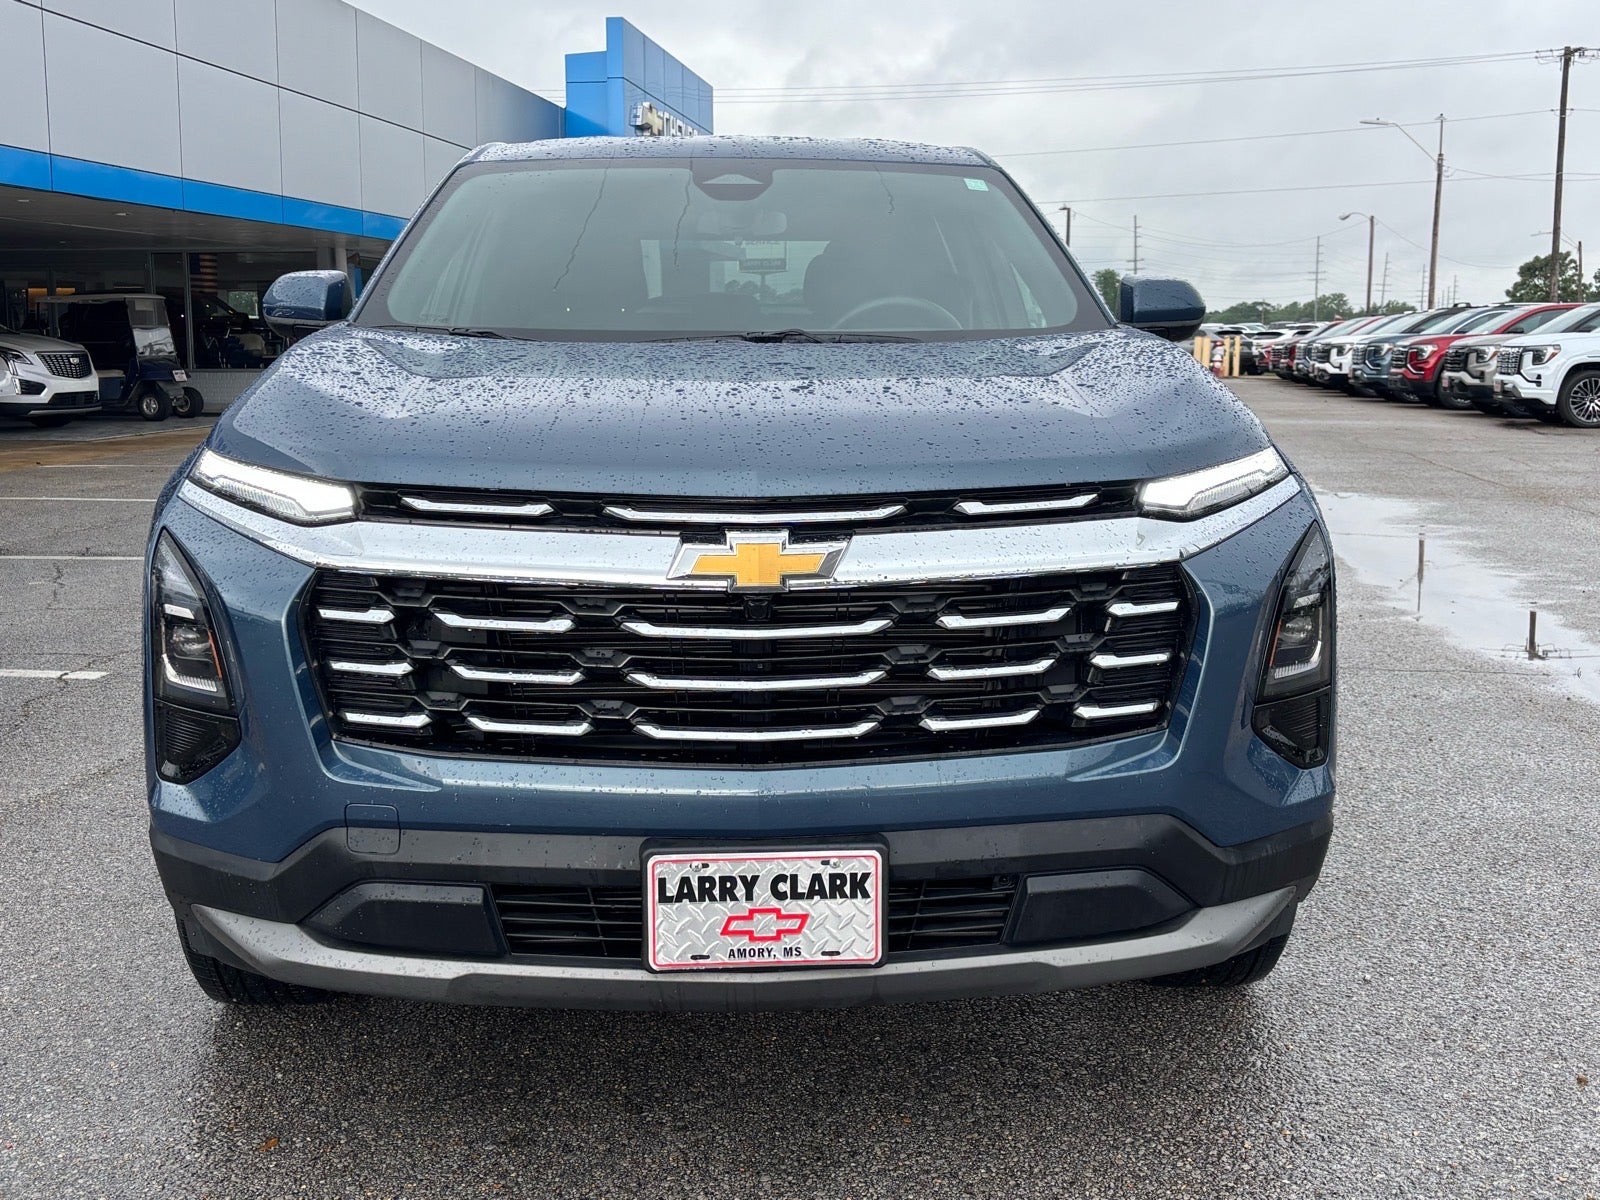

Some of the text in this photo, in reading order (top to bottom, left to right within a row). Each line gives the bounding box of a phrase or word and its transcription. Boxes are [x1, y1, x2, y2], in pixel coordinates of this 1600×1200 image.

[657, 873, 872, 903] LARRY CLARK
[728, 946, 802, 960] AMORY, MS
